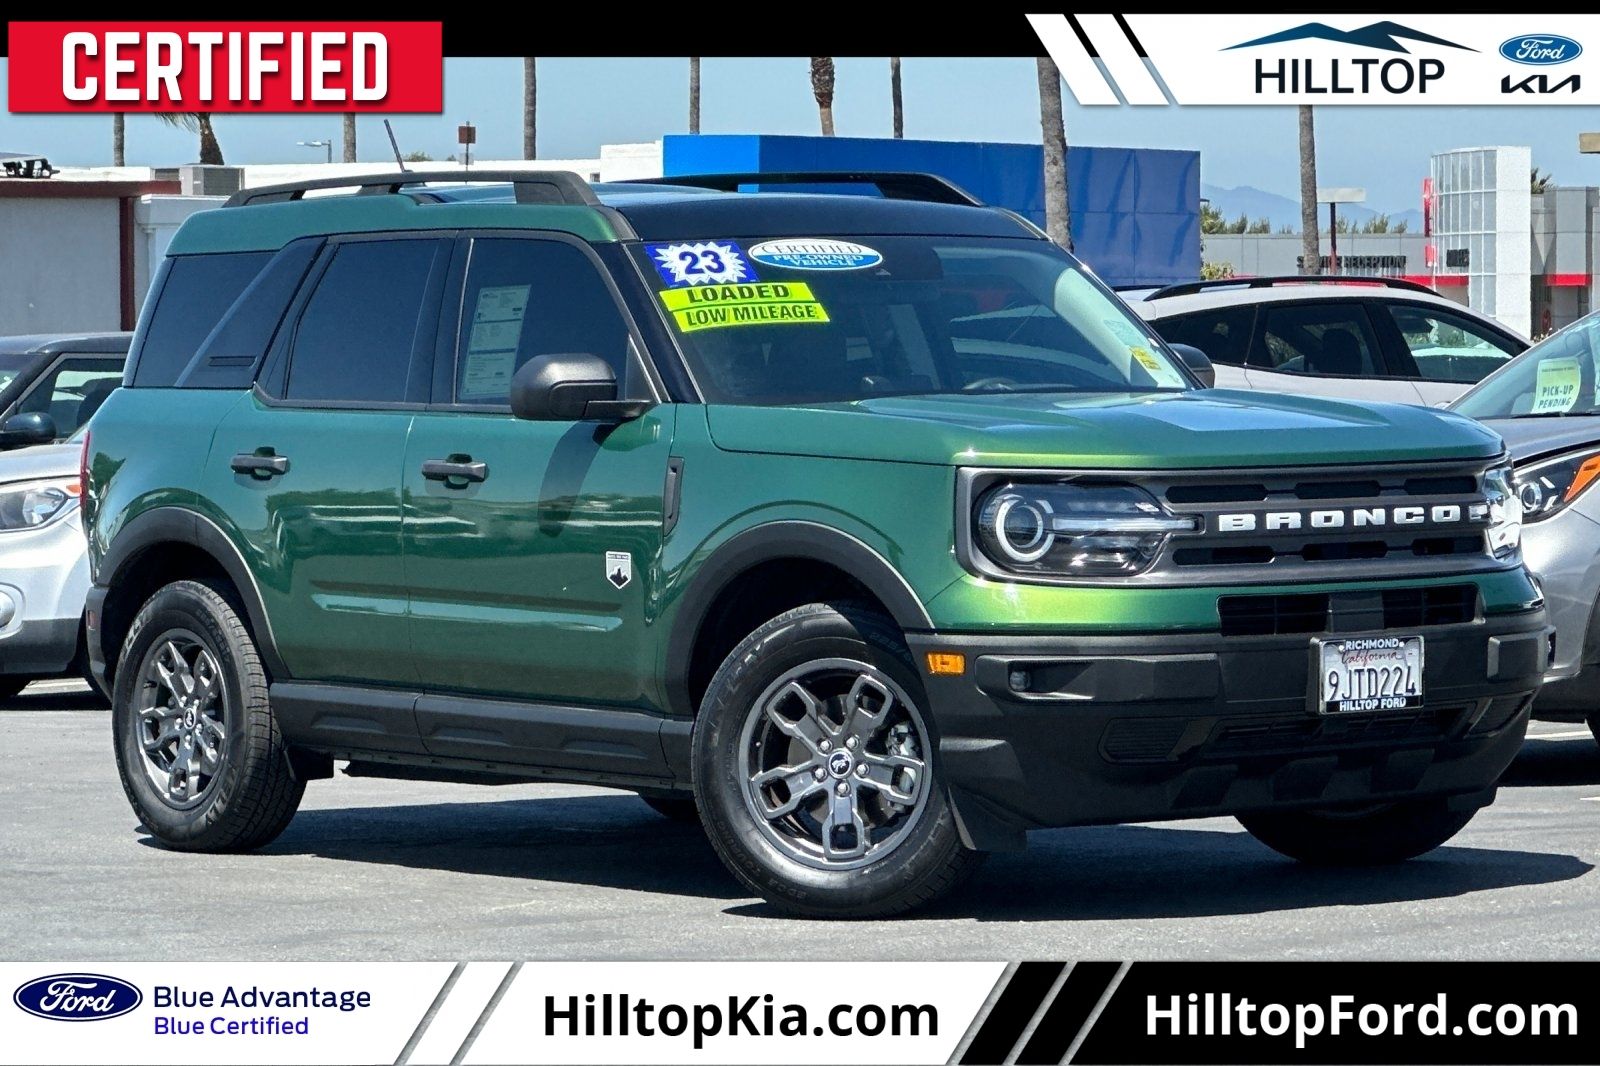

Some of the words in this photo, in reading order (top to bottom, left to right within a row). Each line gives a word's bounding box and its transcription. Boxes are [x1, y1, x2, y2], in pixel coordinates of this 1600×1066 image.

[761, 244, 863, 255] CERTIFIED
[678, 250, 726, 275] 23
[773, 253, 864, 262] PRE-OWNED
[789, 258, 857, 267] VEHICLE
[687, 284, 791, 304] LOADED
[686, 307, 727, 326] LOW
[733, 304, 817, 322] MILEAGE
[1542, 384, 1574, 397] PICK-UP
[1538, 397, 1572, 409] PENDING
[1218, 504, 1461, 532] BRONCO
[1345, 638, 1400, 650] RICHMOND
[1341, 649, 1403, 667] California
[1328, 665, 1417, 701] 9JTD224
[1339, 699, 1379, 712] HILLTOP
[1381, 697, 1407, 709] FORD
